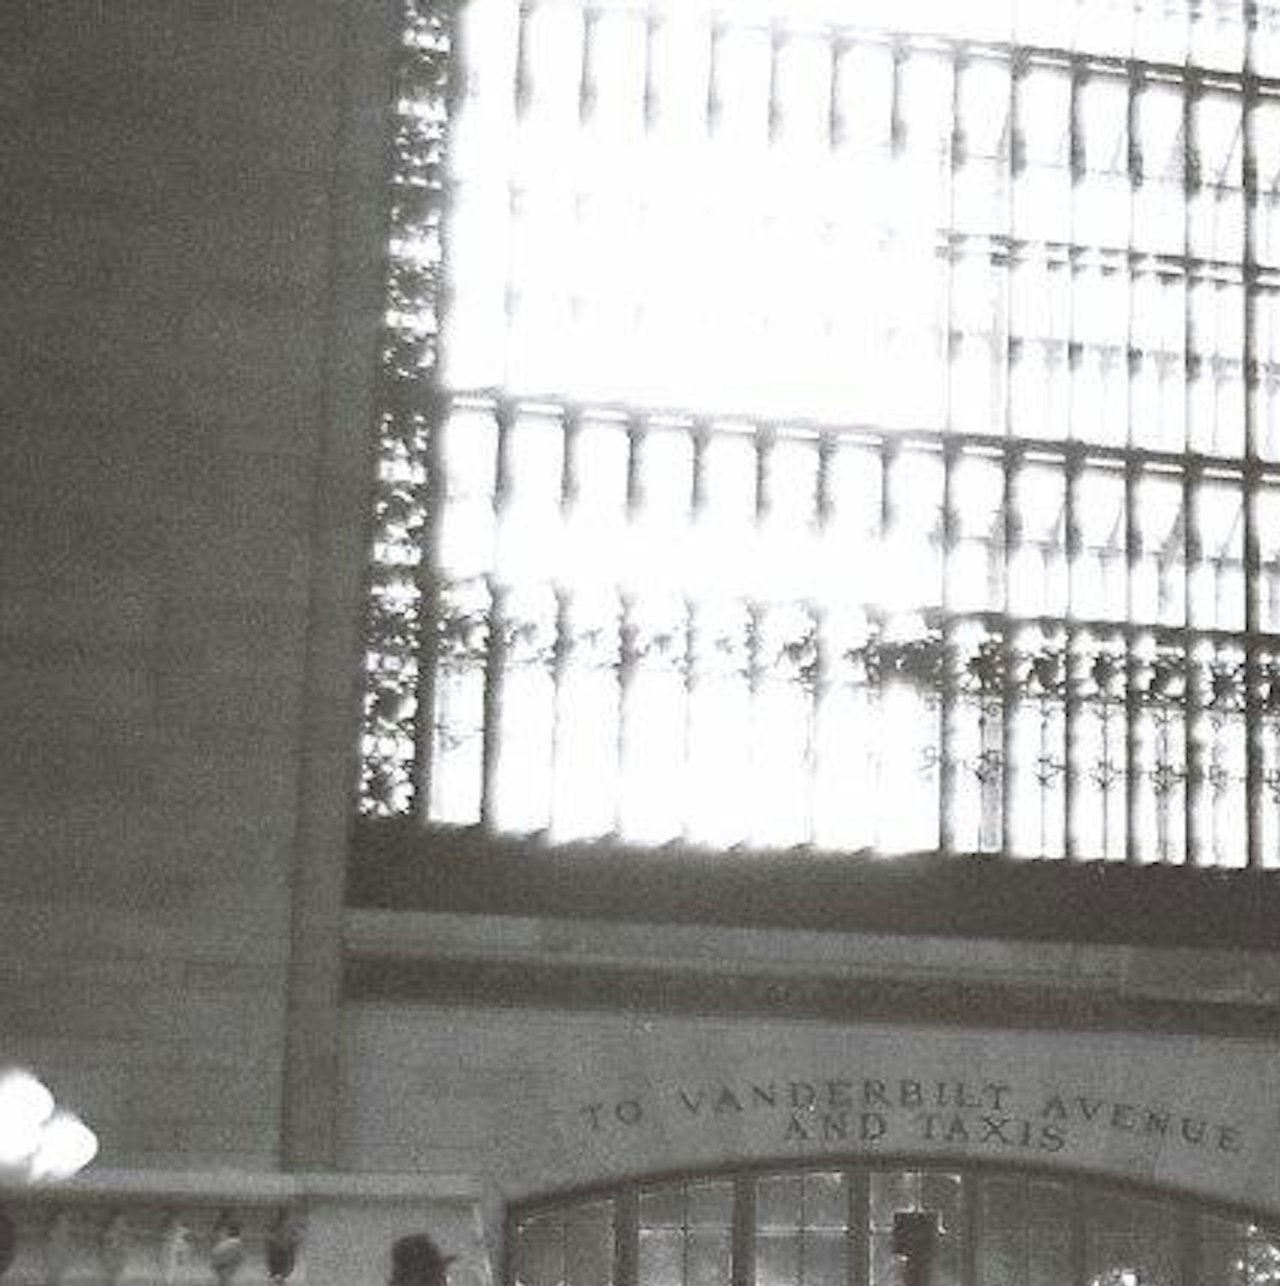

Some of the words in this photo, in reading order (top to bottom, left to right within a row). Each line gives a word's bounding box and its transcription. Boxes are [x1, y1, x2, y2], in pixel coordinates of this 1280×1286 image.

[582, 1099, 643, 1132] TO
[679, 1078, 1010, 1116] VANDERBILT
[1040, 1095, 1242, 1152] AVENUE
[784, 1111, 888, 1141] AND
[920, 1110, 1065, 1152] TAXIS
